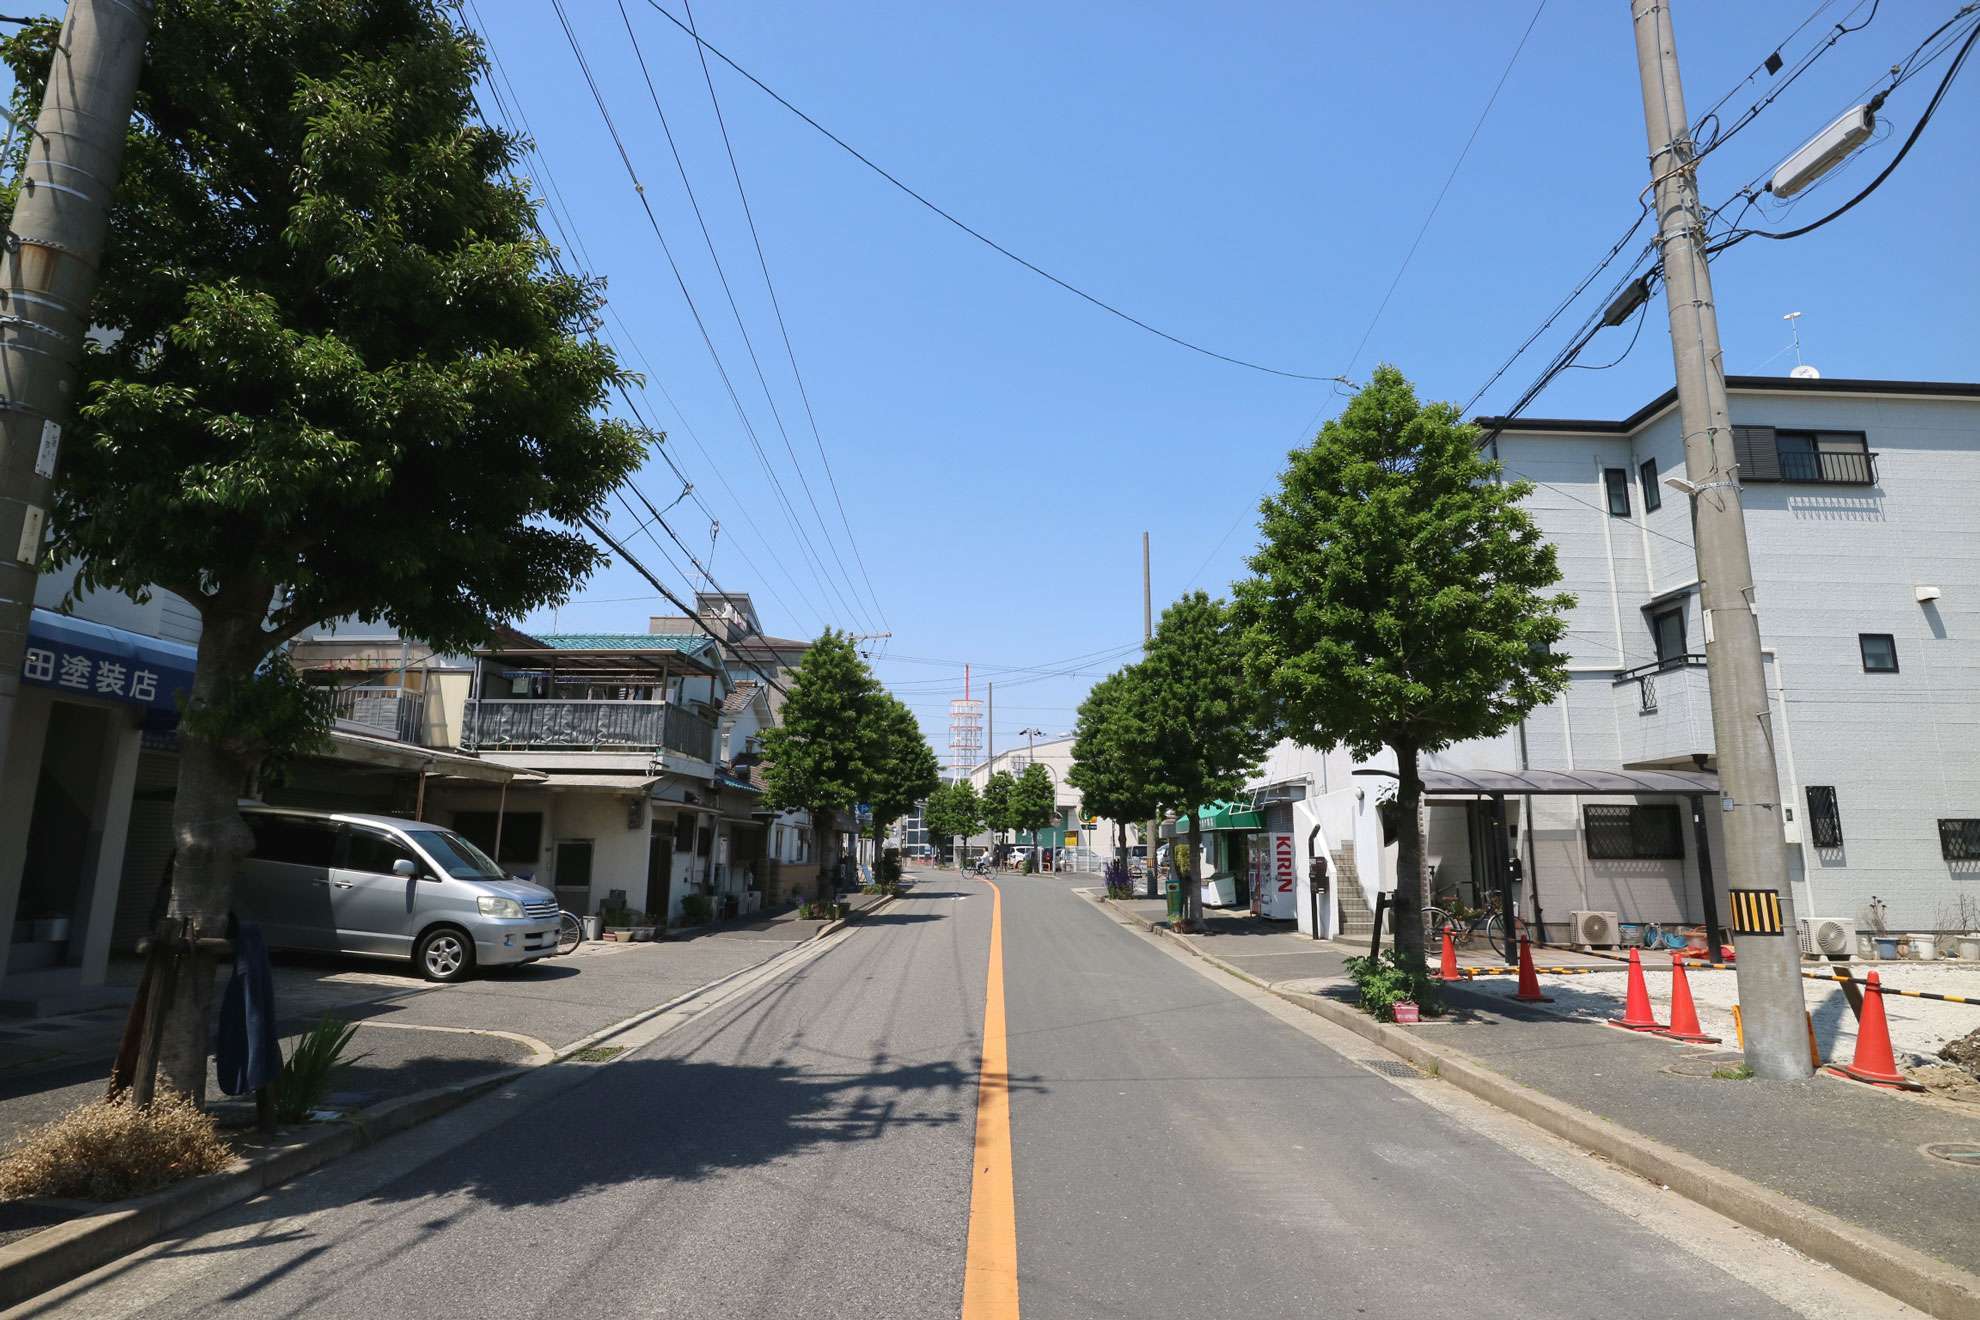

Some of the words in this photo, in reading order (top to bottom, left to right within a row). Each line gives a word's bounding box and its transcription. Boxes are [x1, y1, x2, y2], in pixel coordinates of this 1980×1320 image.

[24, 648, 159, 702] 田塗装店
[1276, 836, 1293, 893] KIRIN
